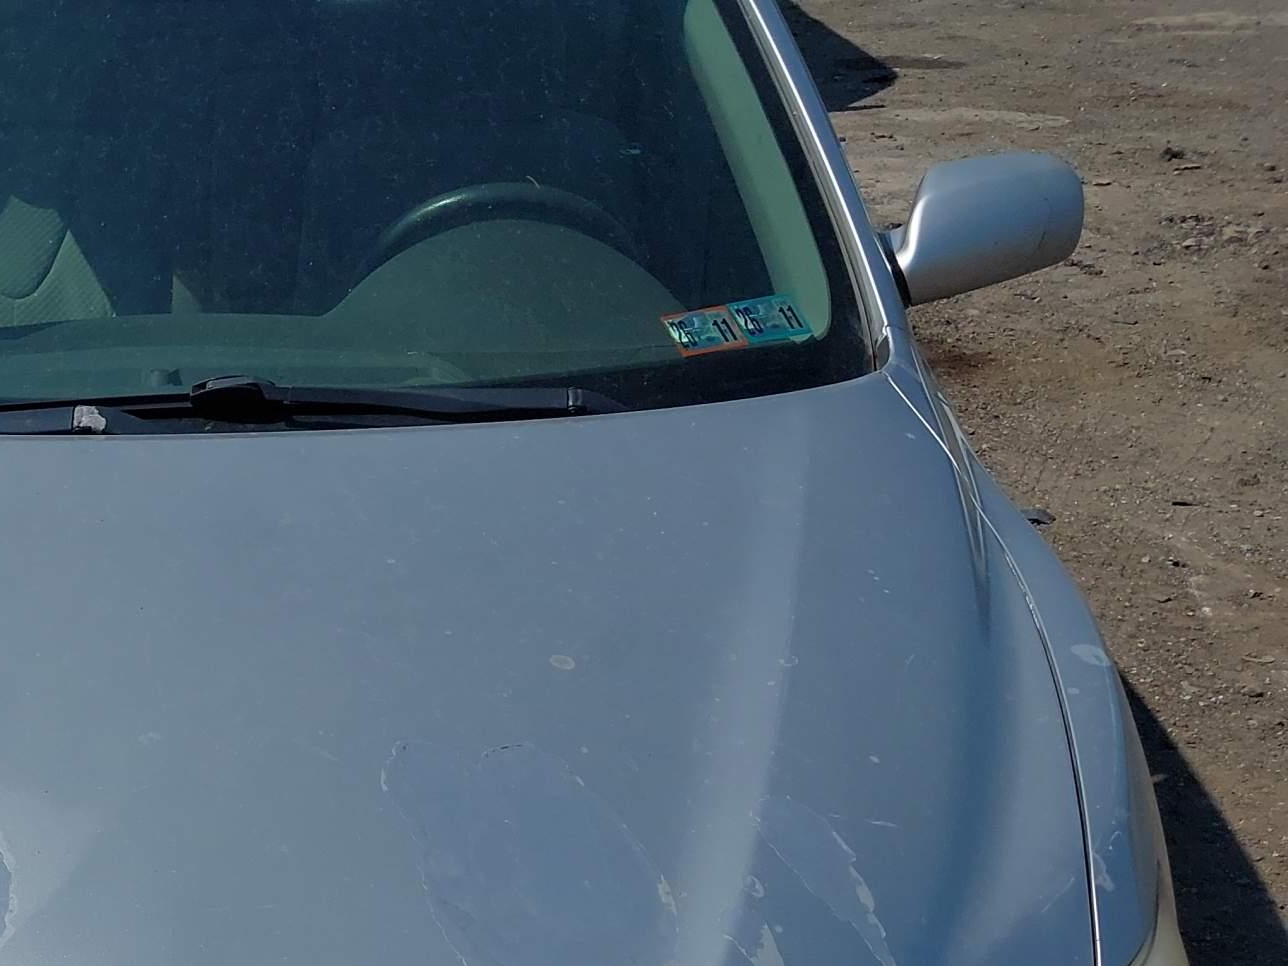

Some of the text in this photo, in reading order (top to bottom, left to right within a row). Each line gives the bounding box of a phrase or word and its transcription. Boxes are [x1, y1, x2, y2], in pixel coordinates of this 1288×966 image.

[668, 318, 739, 349] 26 11
[735, 305, 804, 337] 26 11
